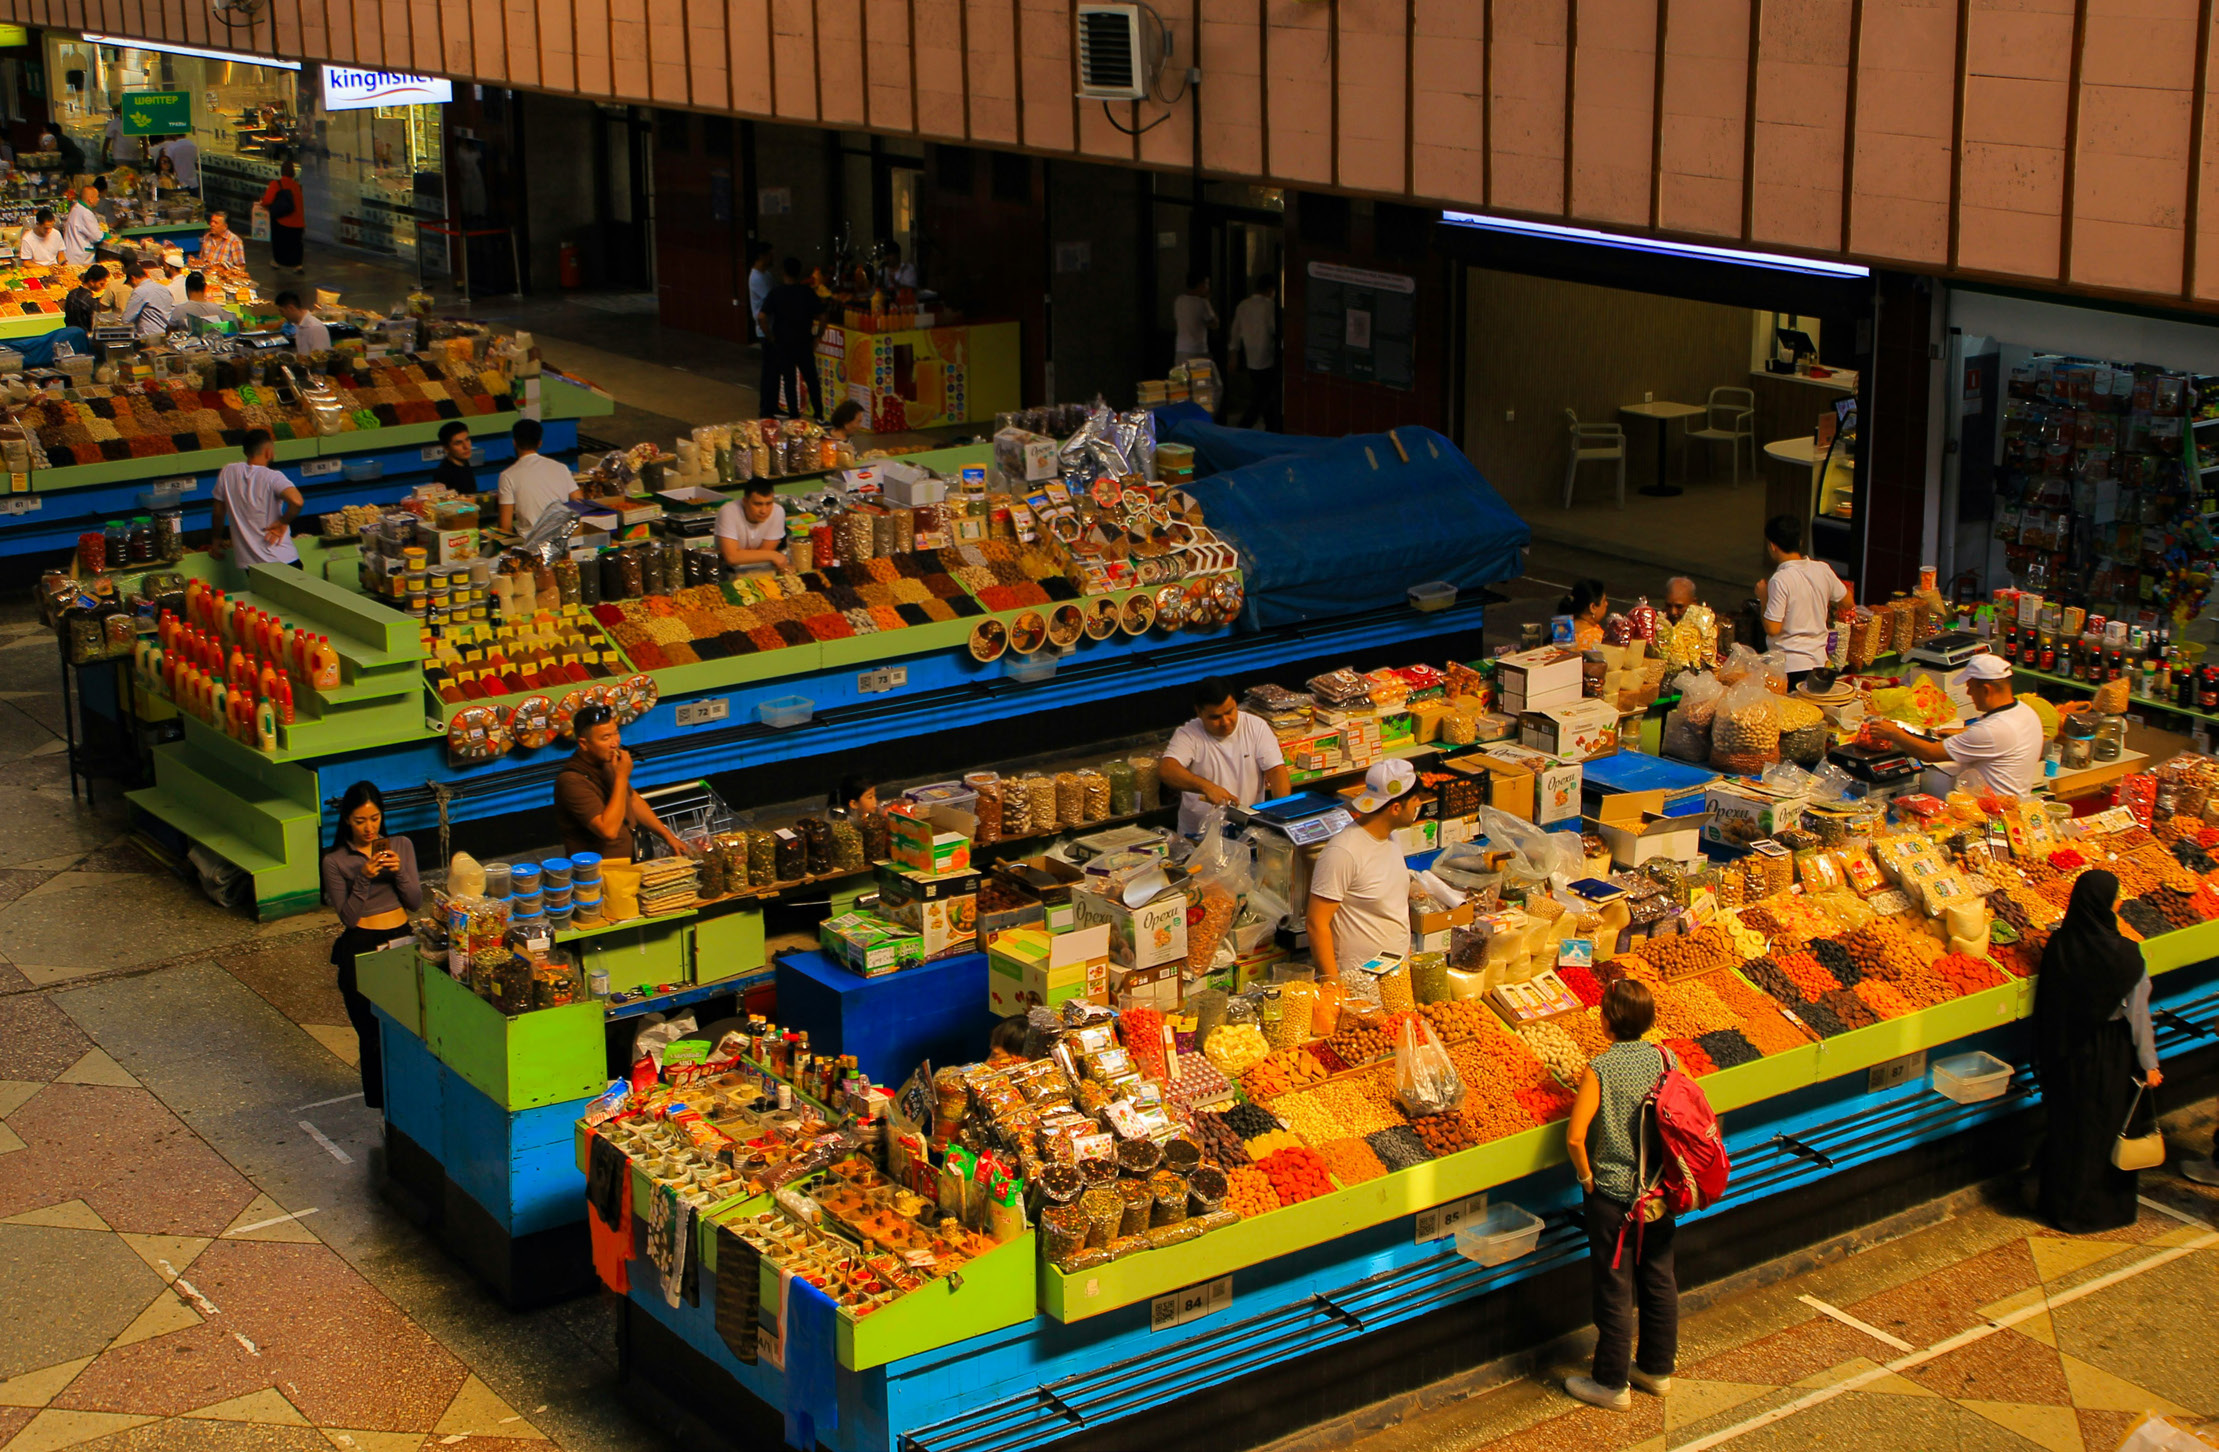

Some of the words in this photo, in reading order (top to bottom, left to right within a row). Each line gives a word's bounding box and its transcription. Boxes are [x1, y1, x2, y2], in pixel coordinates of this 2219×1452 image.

[134, 95, 179, 106] ШӨПТЕР
[878, 676, 888, 684] 73
[698, 708, 708, 716] 72
[1548, 774, 1575, 793] Орехи
[1706, 799, 1750, 822] Орехи
[1076, 901, 1113, 928] Орехи
[1143, 907, 1178, 931] Орехи
[1893, 1065, 1904, 1078] 87
[1445, 1213, 1459, 1225] 85
[1185, 1297, 1202, 1311] 84
